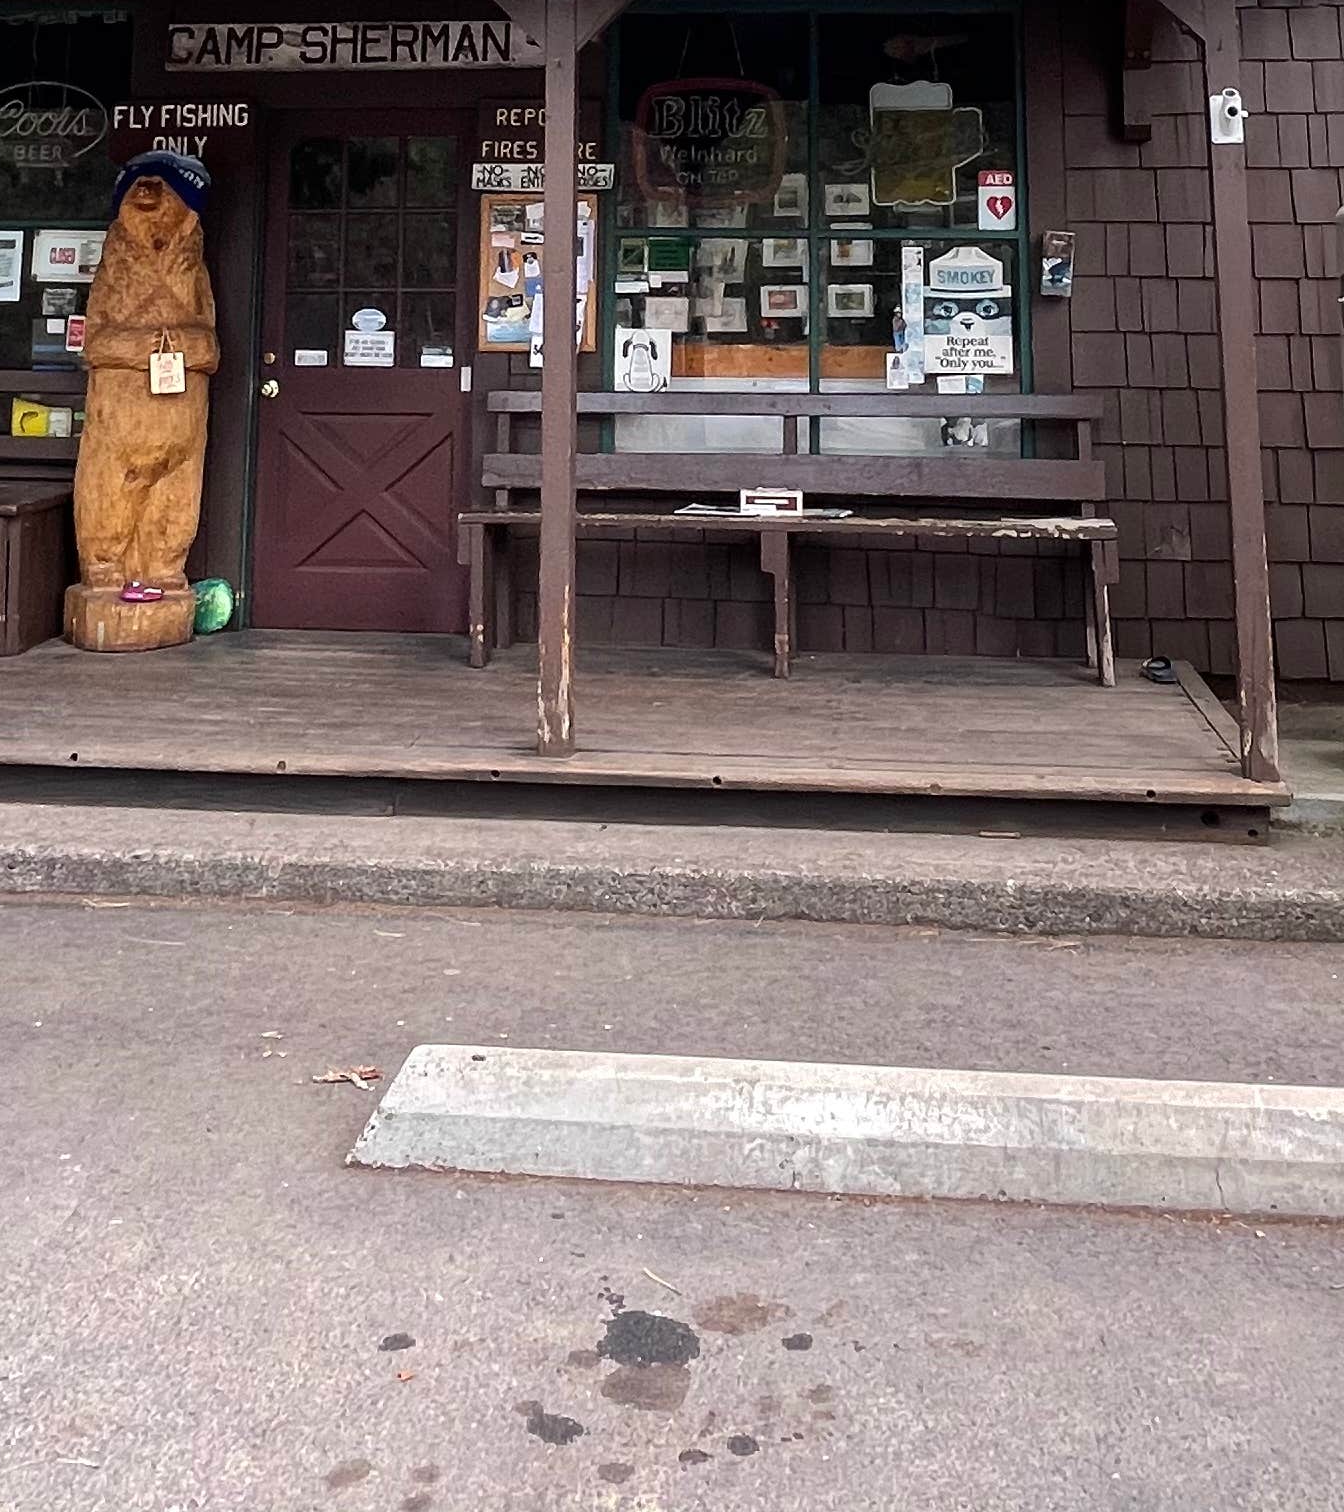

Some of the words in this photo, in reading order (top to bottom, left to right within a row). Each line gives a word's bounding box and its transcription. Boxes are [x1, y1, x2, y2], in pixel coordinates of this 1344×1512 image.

[114, 105, 154, 128] FLY
[161, 103, 249, 128] FISHING
[496, 108, 546, 126] REPO
[649, 96, 768, 138] Blitz
[14, 145, 62, 161] BEER
[153, 136, 207, 158] ONLY
[482, 141, 538, 159] FIRES
[985, 174, 1012, 185] AED
[936, 269, 994, 284] SMOKEY
[946, 336, 989, 348] Repeat
[942, 347, 970, 357] after
